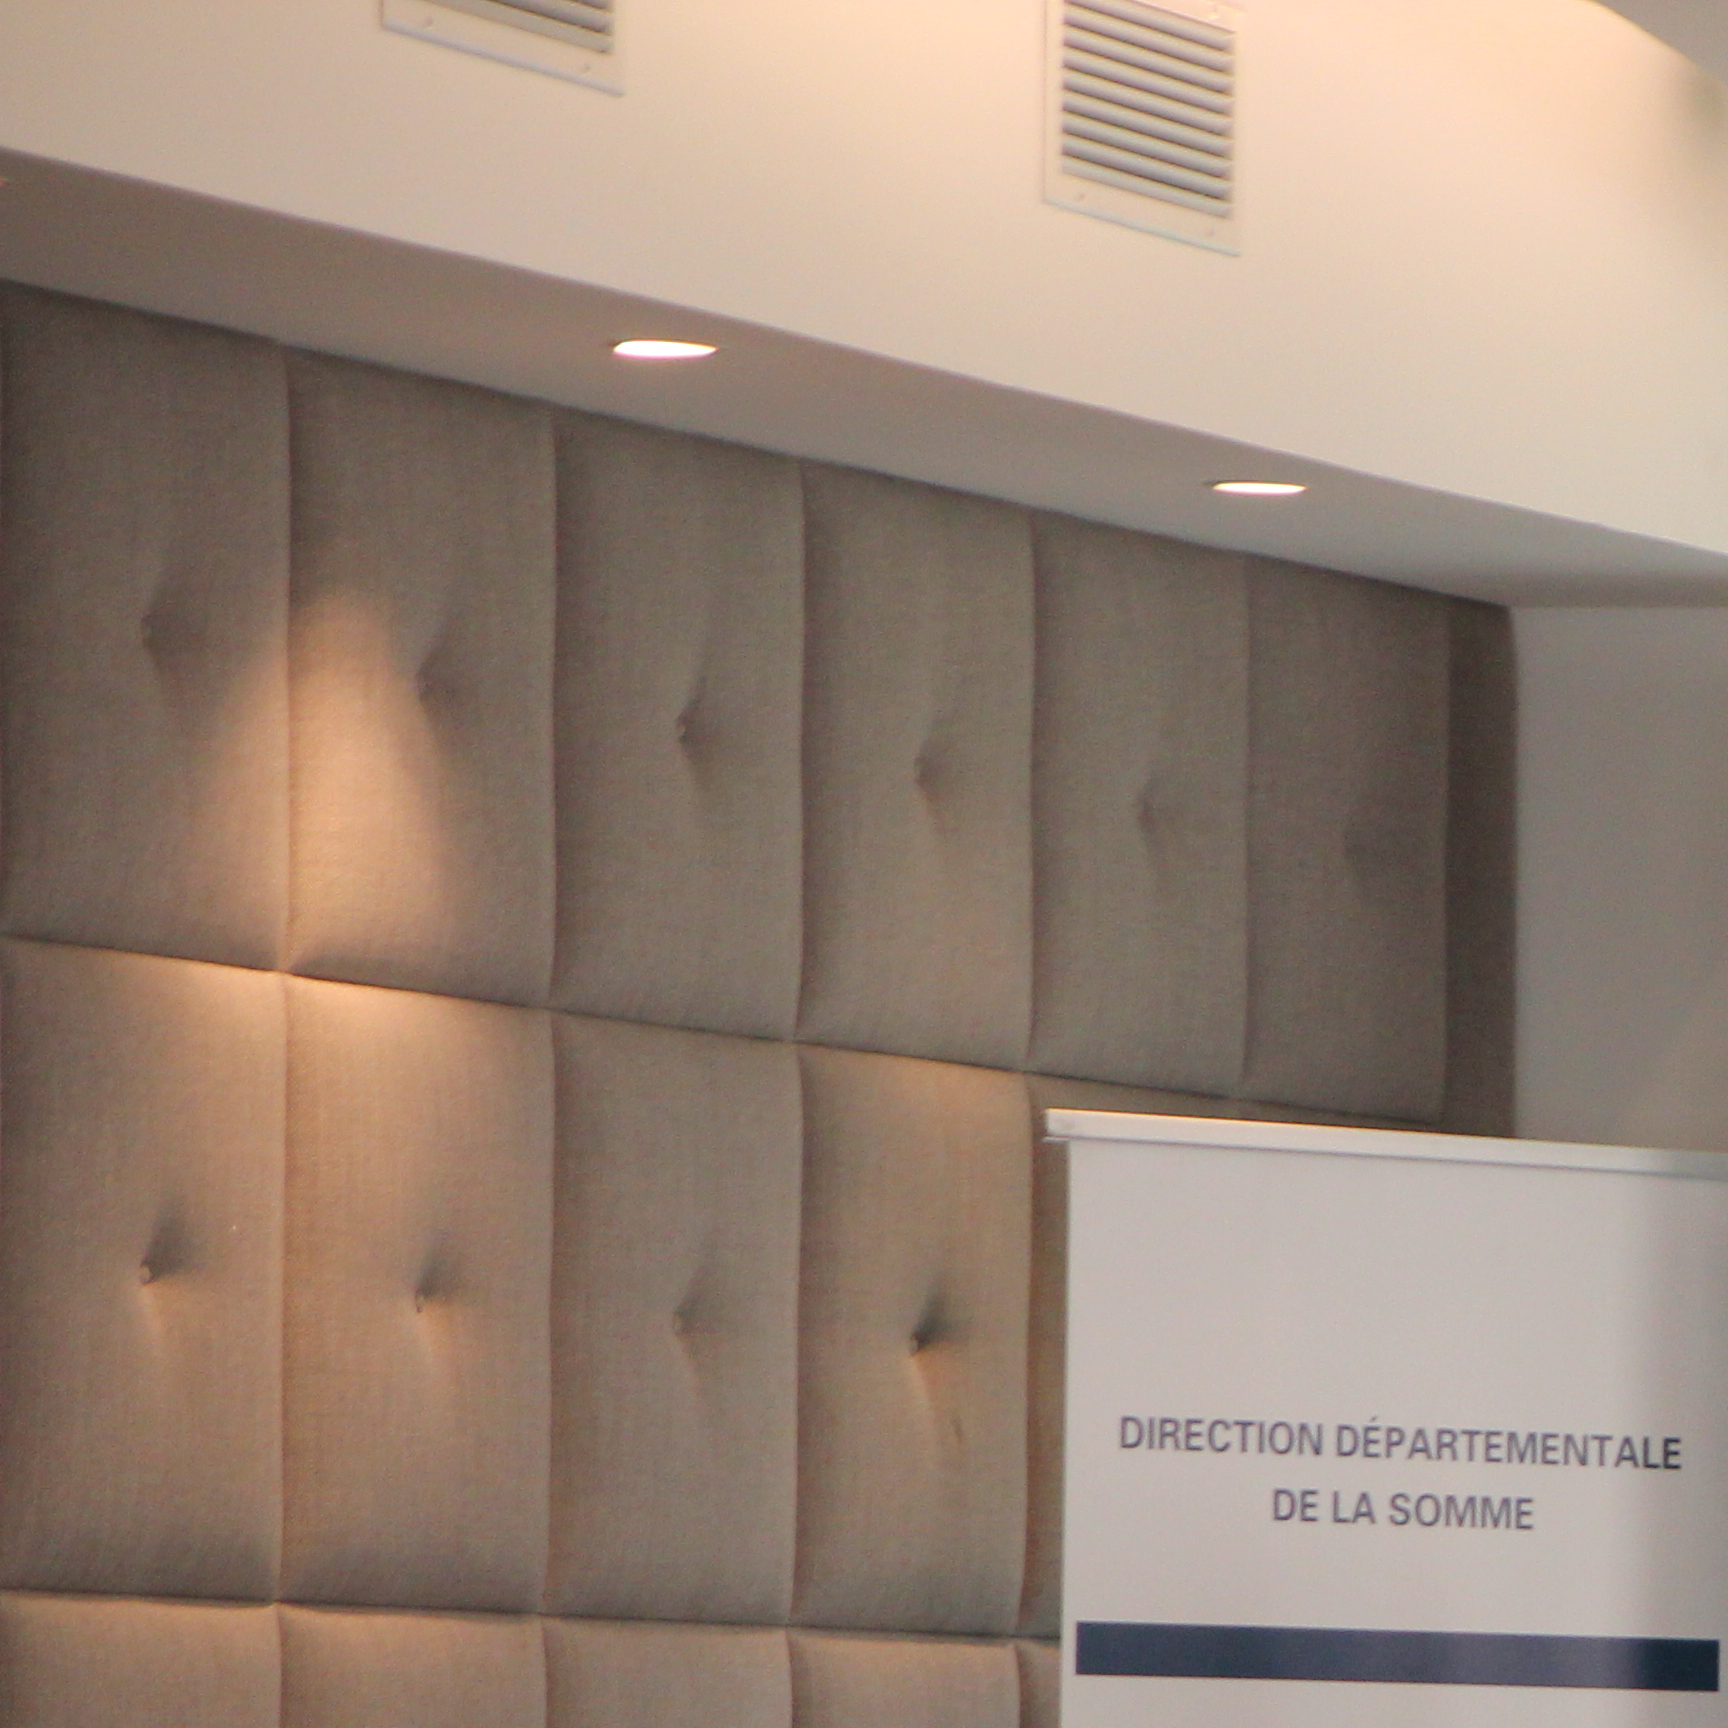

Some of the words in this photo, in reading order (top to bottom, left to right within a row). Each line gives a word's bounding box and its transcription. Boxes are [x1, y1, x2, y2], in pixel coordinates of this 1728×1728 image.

[1119, 1415, 1323, 1457] DIRECTION
[1335, 1417, 1683, 1470] DÉPARTEMENTALE
[1272, 1488, 1319, 1523] DE
[1332, 1491, 1377, 1525] LA
[1388, 1492, 1535, 1531] SOMME
